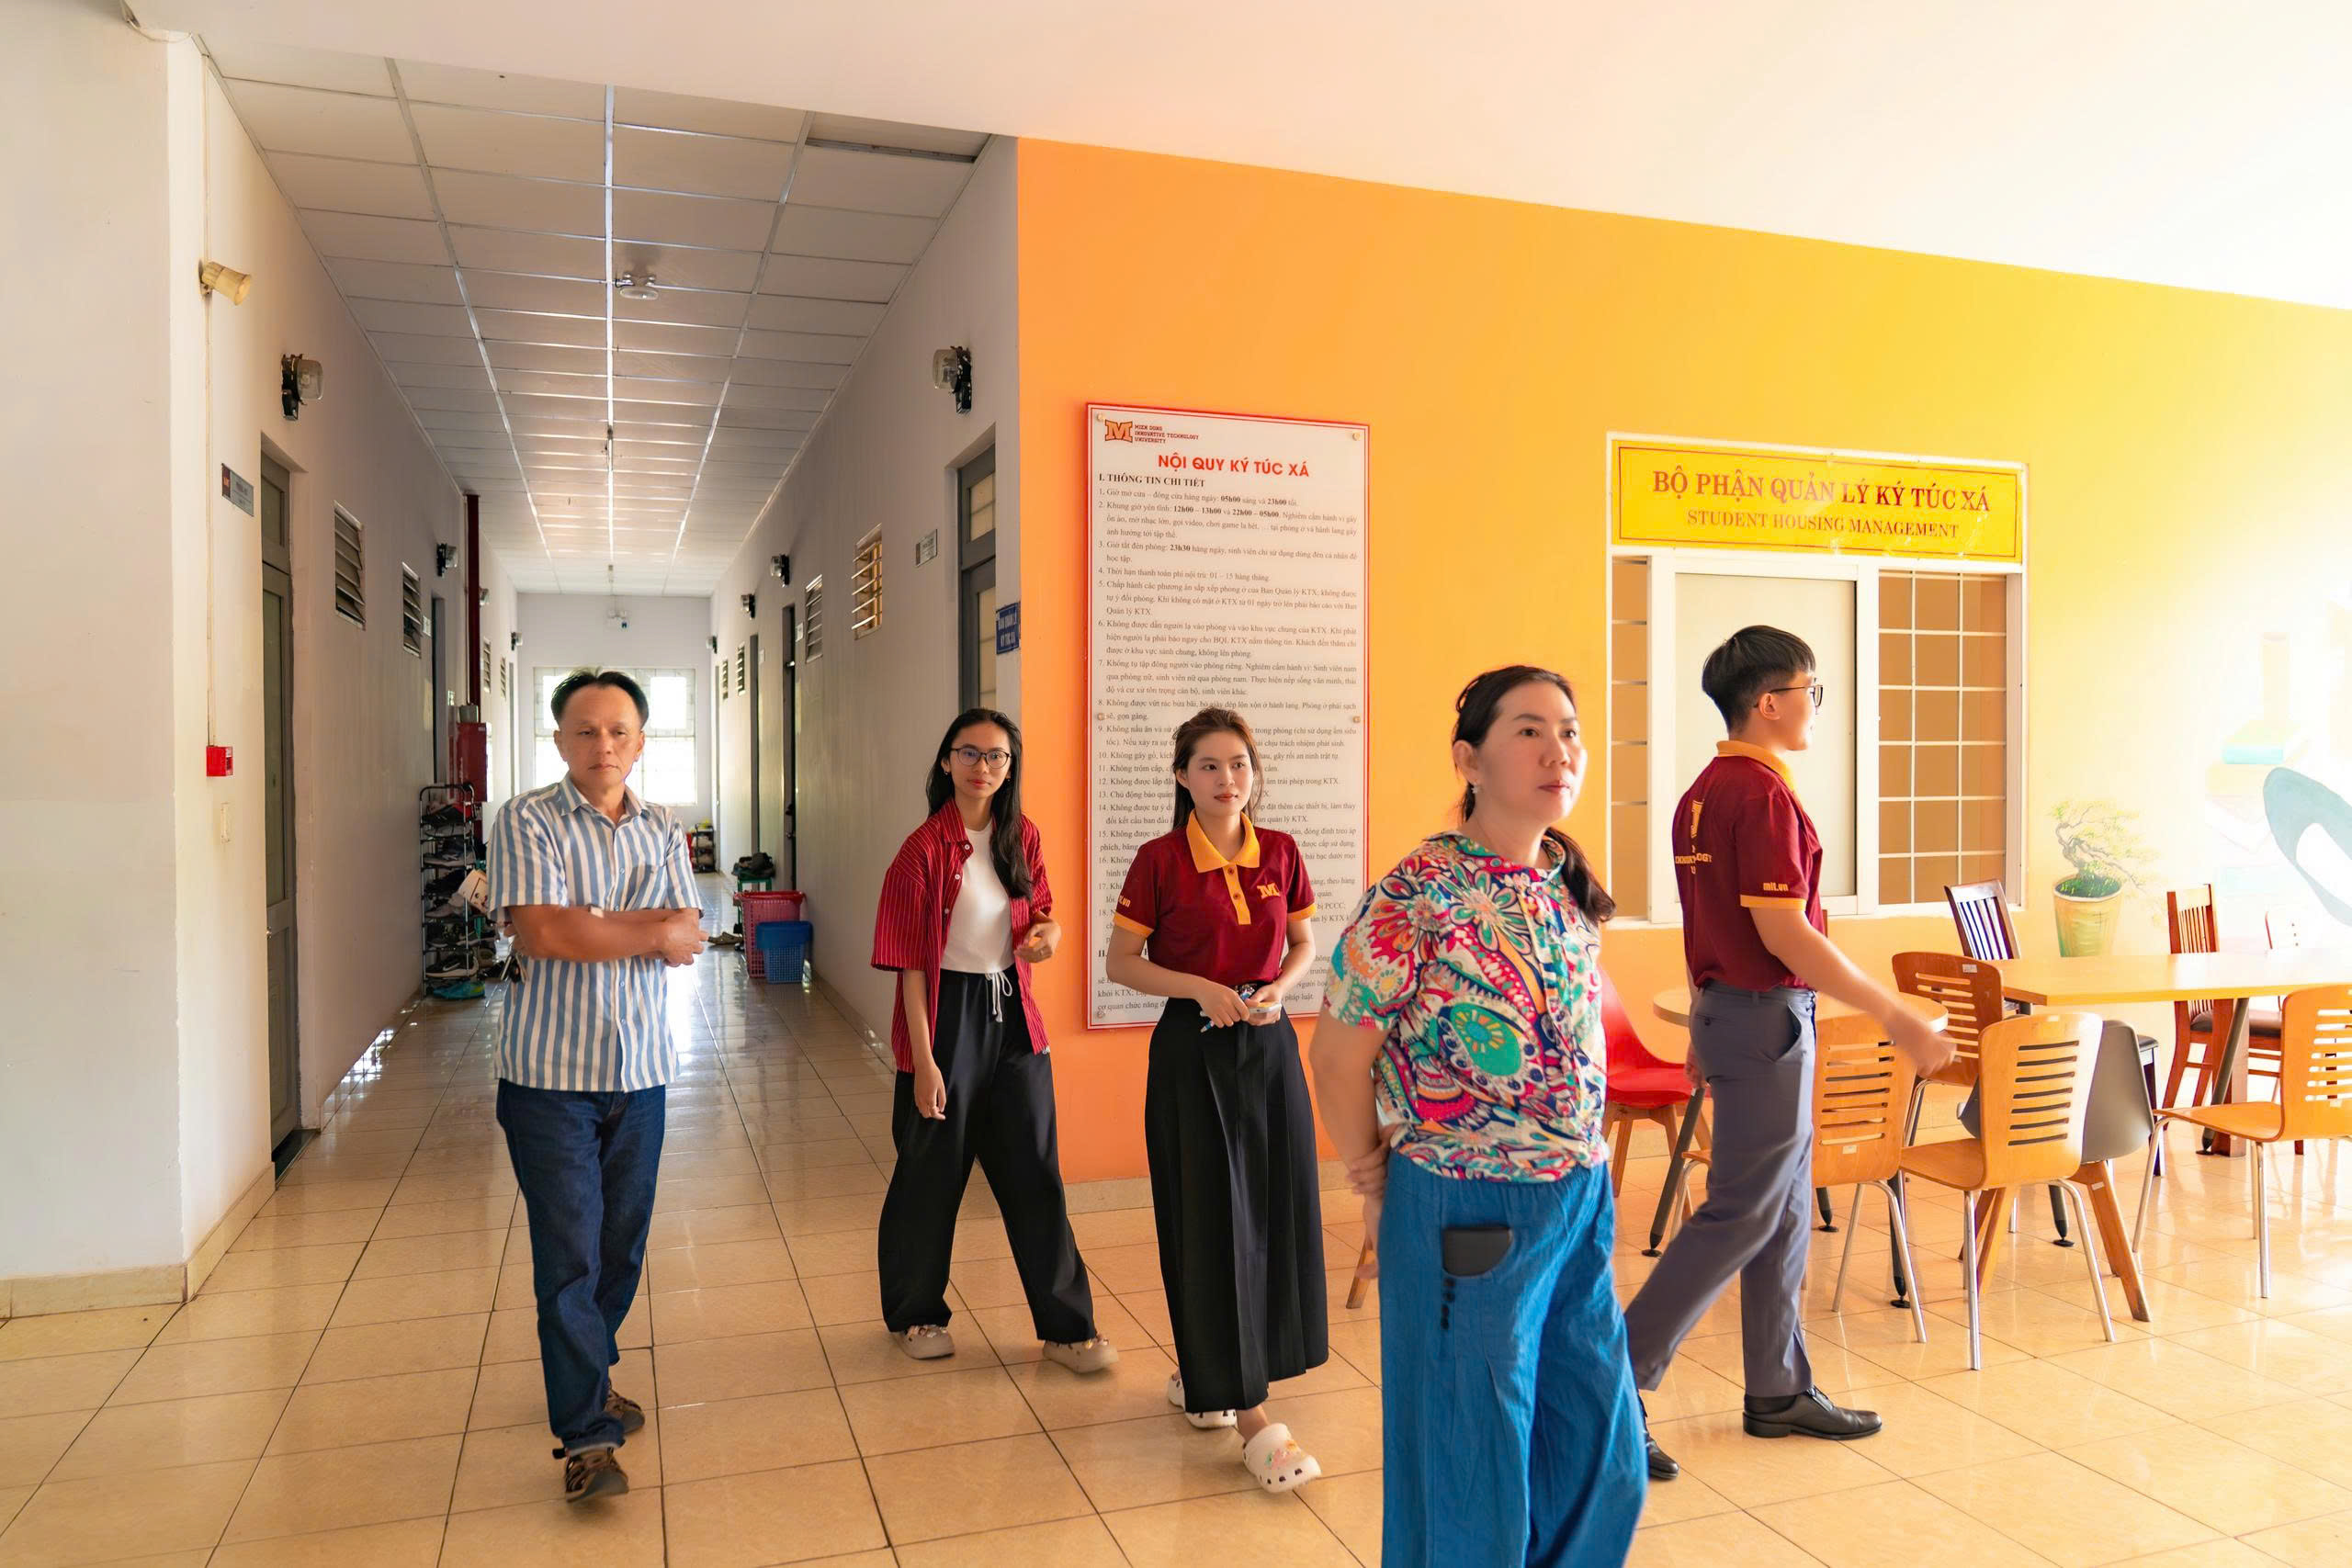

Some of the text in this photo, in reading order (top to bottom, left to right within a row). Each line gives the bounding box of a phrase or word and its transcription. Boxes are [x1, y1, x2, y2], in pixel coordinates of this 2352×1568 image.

[1158, 450, 1308, 477] NỘI QUY KÝ TÚC XÁ
[1108, 471, 1142, 484] THÔNG
[1145, 475, 1161, 485] TIN
[1163, 477, 1180, 486] CHI
[1183, 475, 1204, 487] TIẾT
[1653, 467, 1990, 512] BỘ PHẬN QUẢN LÝ KÝ TÚC XÁ
[1220, 494, 1240, 503] 05h00
[1267, 497, 1286, 506] 23h00
[1687, 510, 1959, 538] STUDENT HOUSING MANAGEMENT
[1170, 543, 1190, 552] 23h30
[1256, 882, 1280, 900] M
